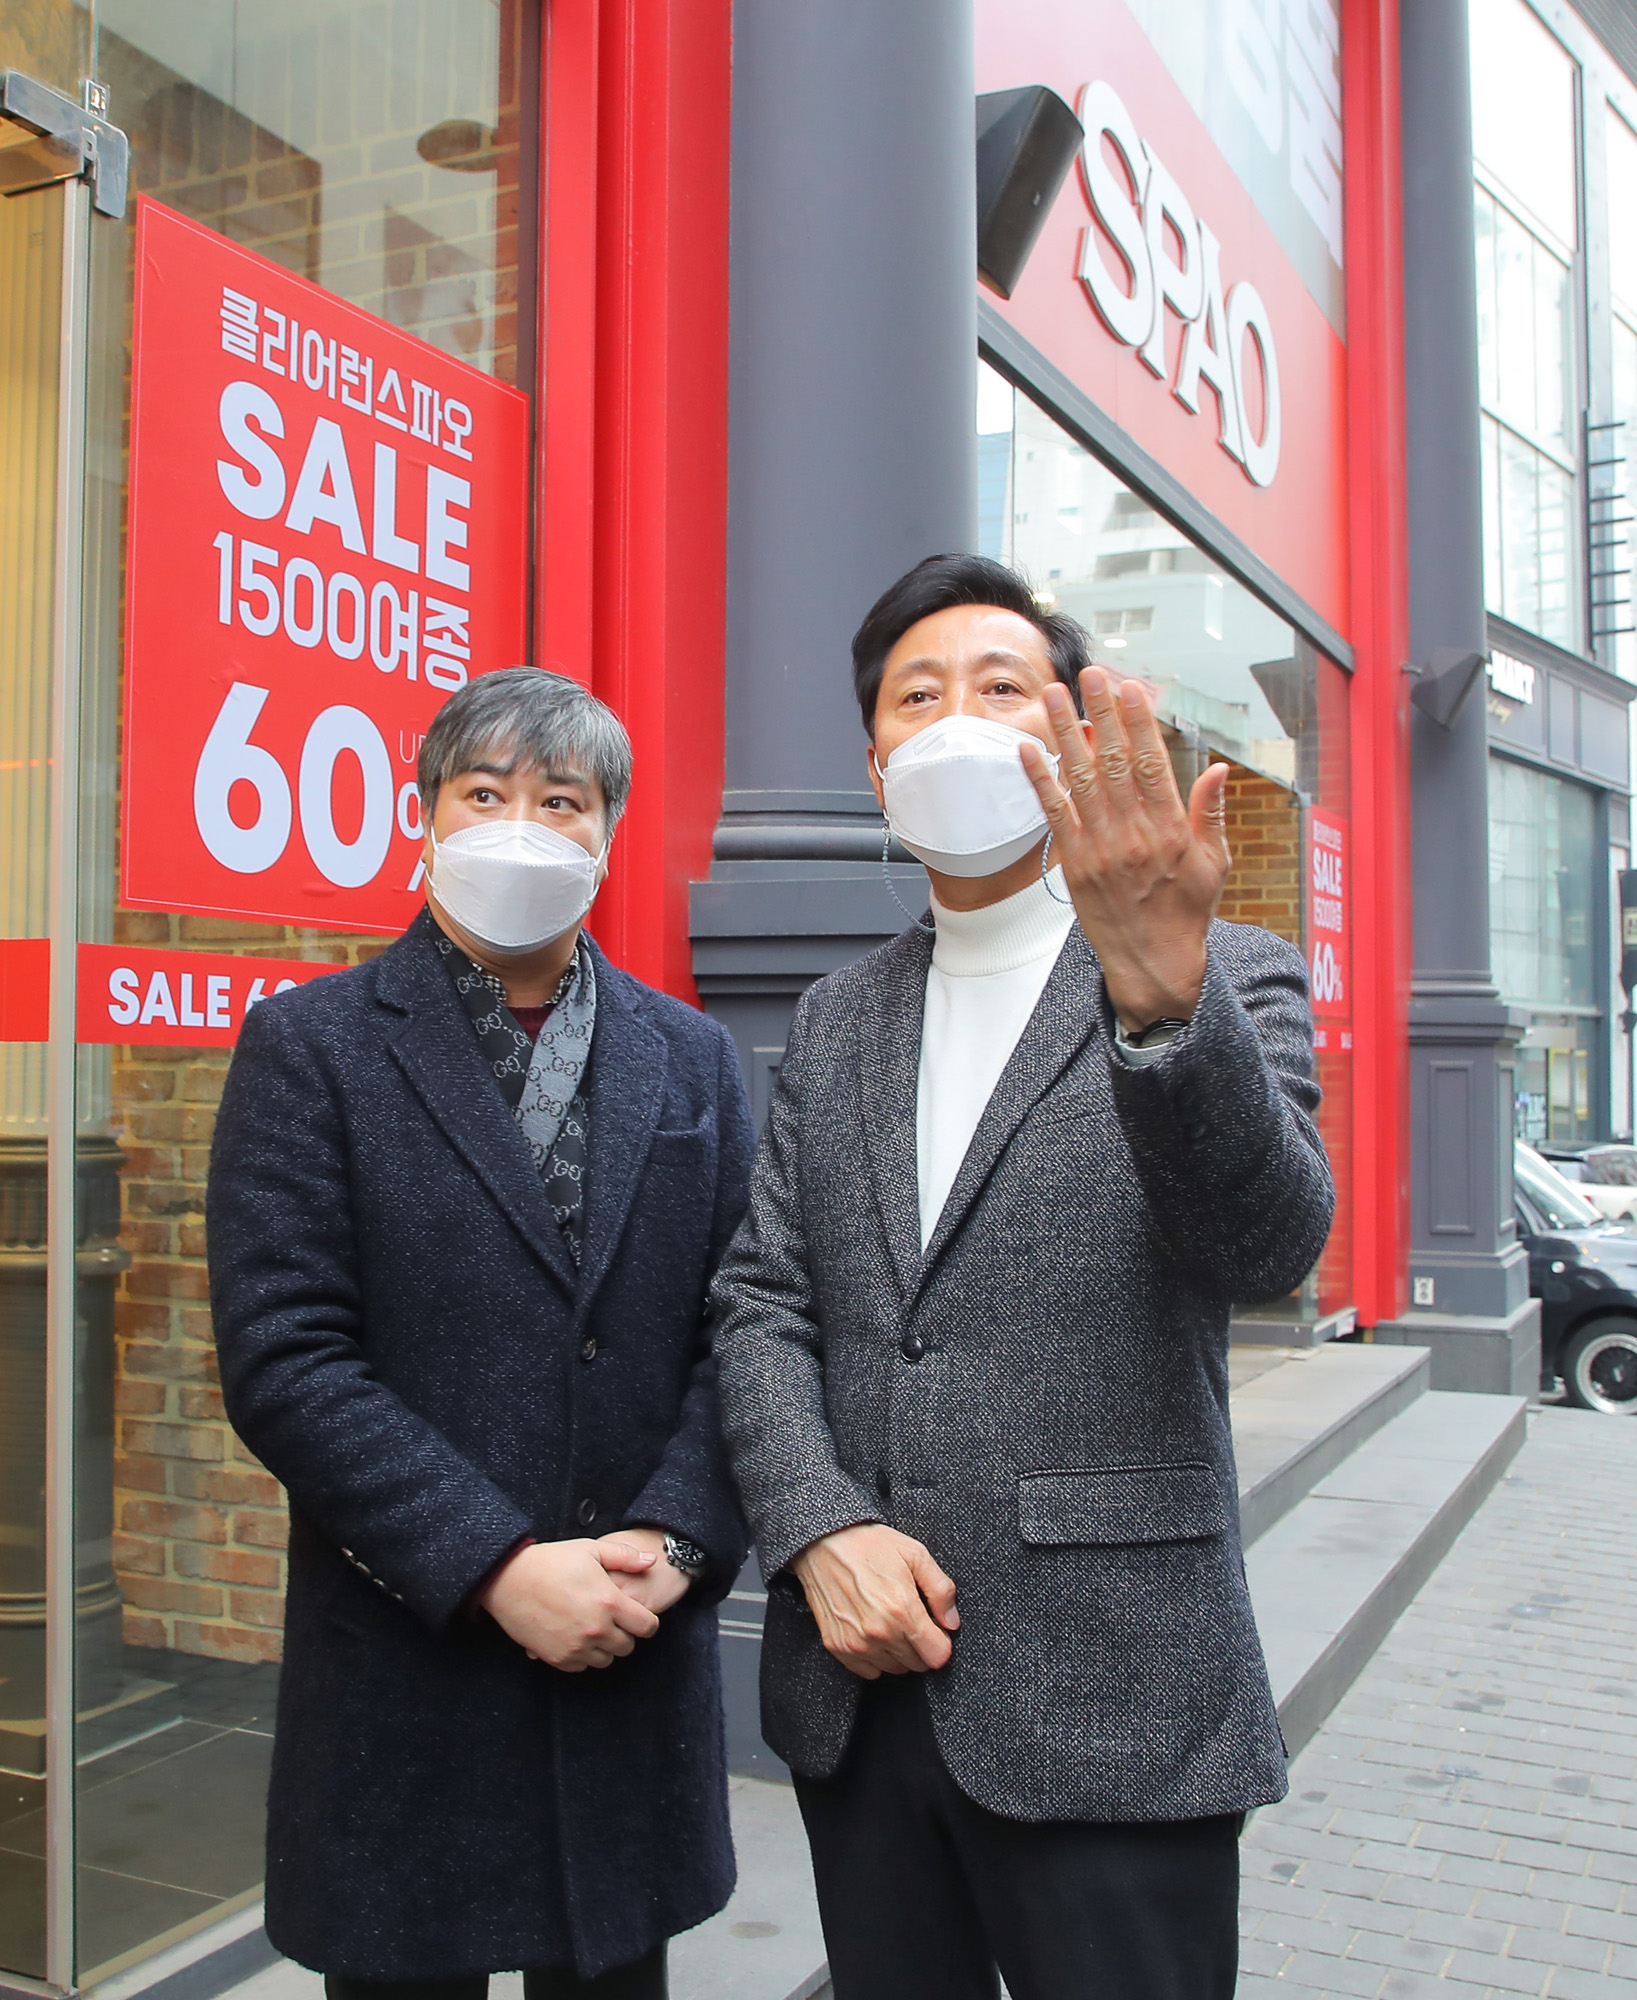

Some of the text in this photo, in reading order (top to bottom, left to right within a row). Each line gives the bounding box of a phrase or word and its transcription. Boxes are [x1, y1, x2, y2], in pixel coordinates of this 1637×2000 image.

[1075, 79, 1281, 488] SPAO
[219, 285, 474, 462] 클리어런스파오
[216, 380, 472, 593] SALE
[211, 530, 472, 693] 1500여종
[1313, 846, 1343, 897] SALE
[107, 966, 232, 1029] SALE
